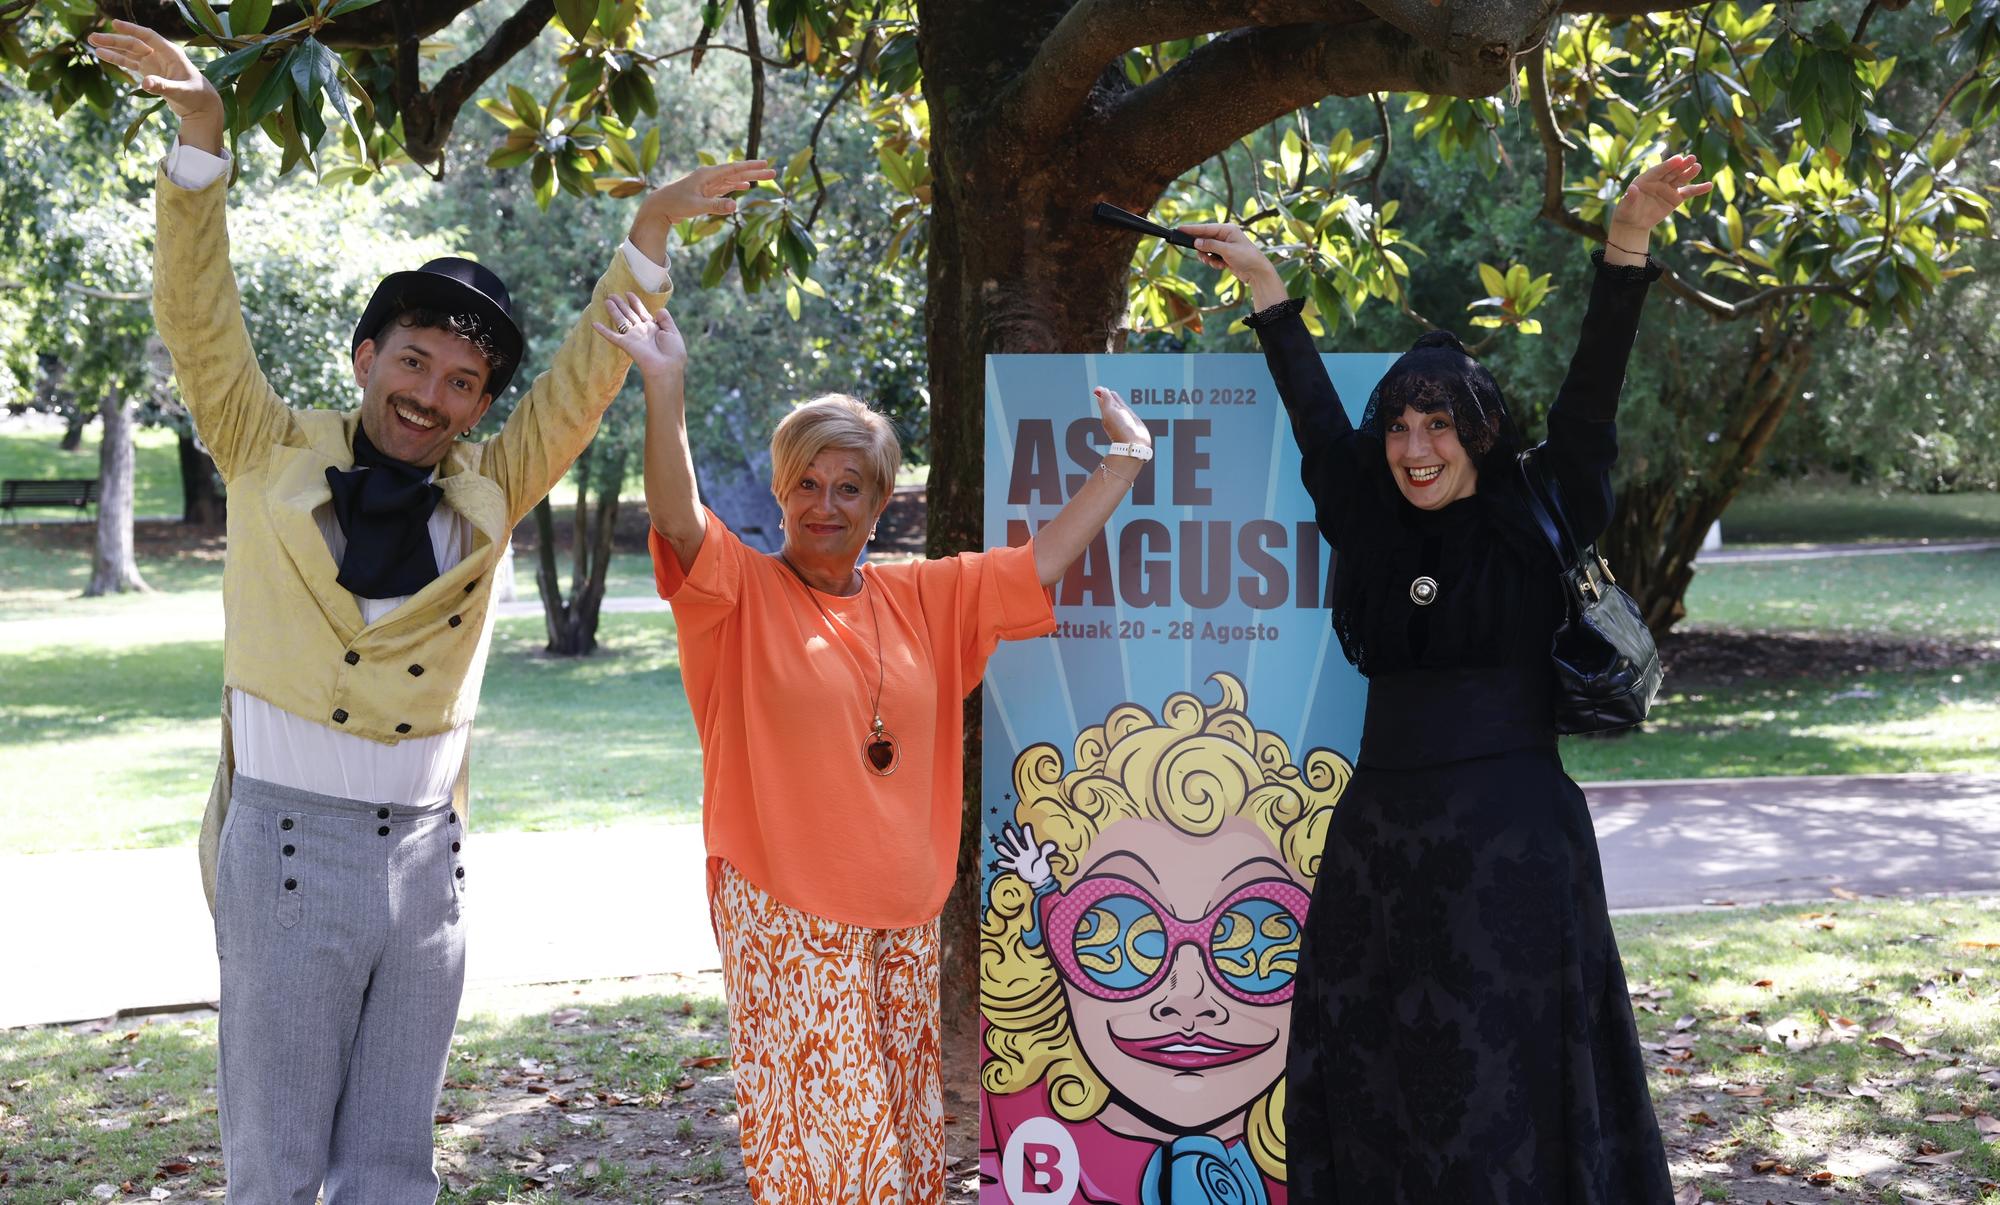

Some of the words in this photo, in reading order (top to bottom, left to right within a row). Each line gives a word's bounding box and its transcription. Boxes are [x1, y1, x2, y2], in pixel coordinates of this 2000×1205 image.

[1130, 388, 1204, 405] BILBAO
[1209, 388, 1257, 405] 2022
[1006, 519, 1337, 610] AGUSI
[1119, 620, 1145, 639] 20
[1167, 620, 1194, 640] 28
[1200, 621, 1279, 645] Agosto
[1022, 1142, 1064, 1194] B
